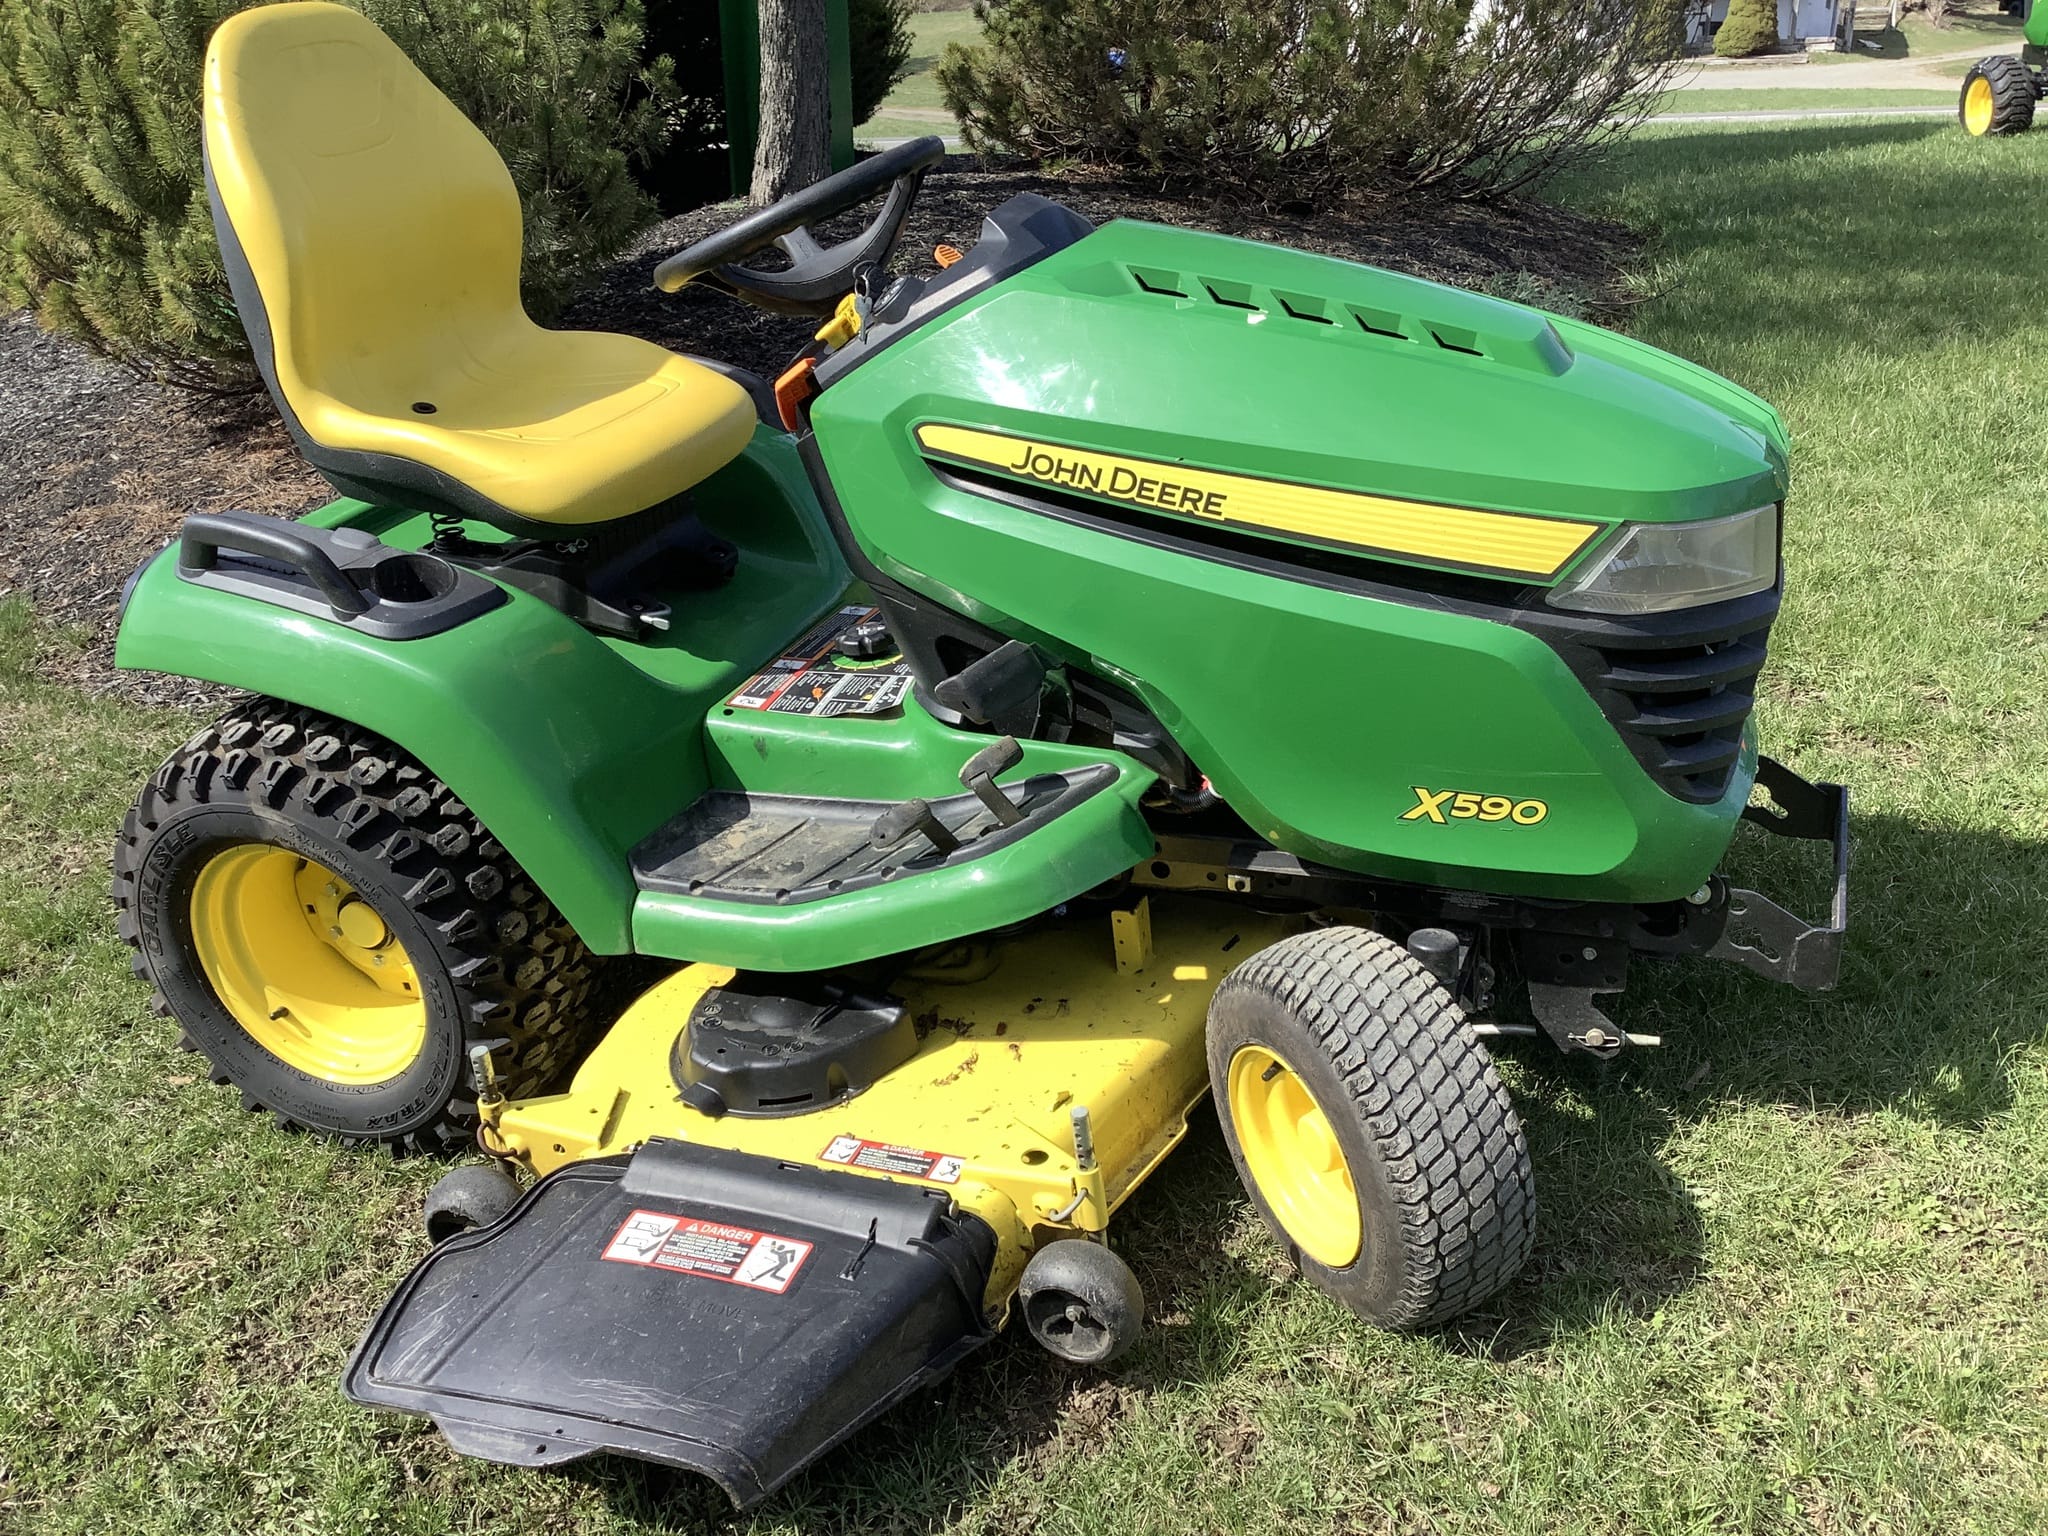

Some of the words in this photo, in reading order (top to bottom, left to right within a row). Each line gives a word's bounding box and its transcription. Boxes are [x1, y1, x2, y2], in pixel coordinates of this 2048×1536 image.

[1011, 446, 1102, 490] JOHN
[1109, 466, 1228, 517] DEERE
[1397, 786, 1550, 826] X590
[143, 823, 198, 957] CARLISLE
[890, 1144, 926, 1156] DANGER
[700, 1223, 756, 1242] DANGER
